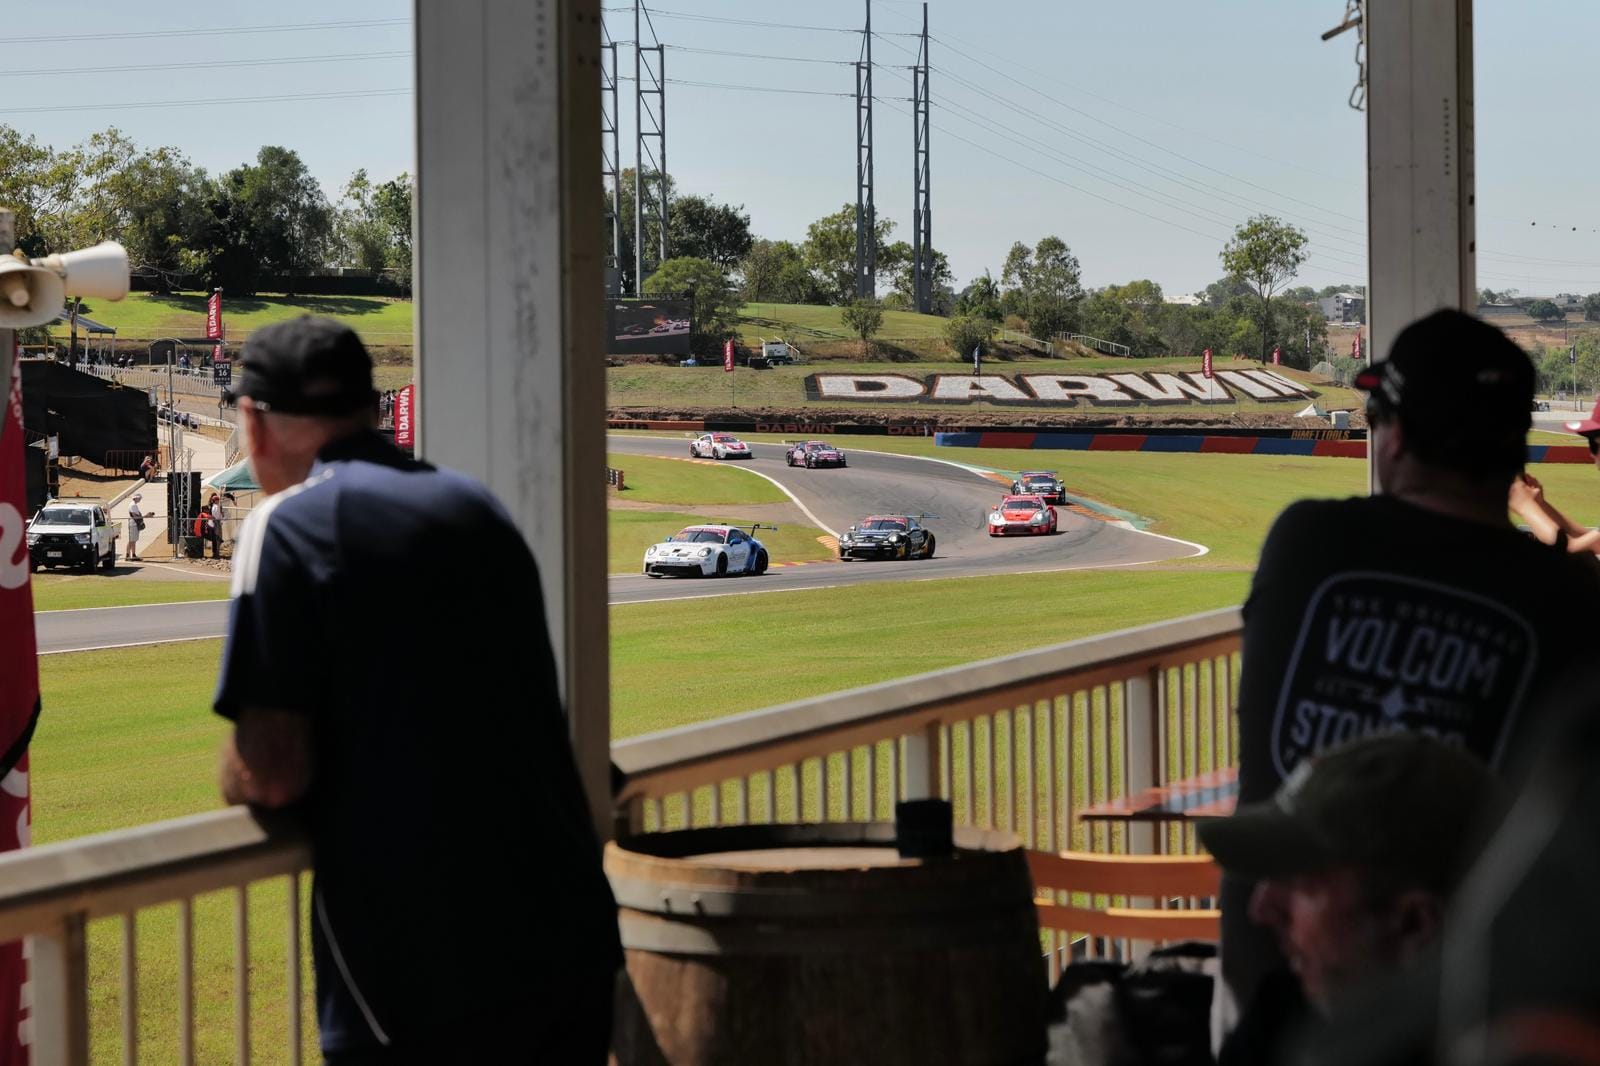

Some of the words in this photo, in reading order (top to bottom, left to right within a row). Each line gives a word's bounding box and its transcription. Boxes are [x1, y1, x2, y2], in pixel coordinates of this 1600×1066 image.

[816, 368, 1312, 402] DARWIN
[756, 423, 834, 433] DARWIN
[1320, 429, 1351, 440] TOOLS
[1325, 616, 1502, 699] VOLCOM
[1290, 697, 1409, 757] STO
